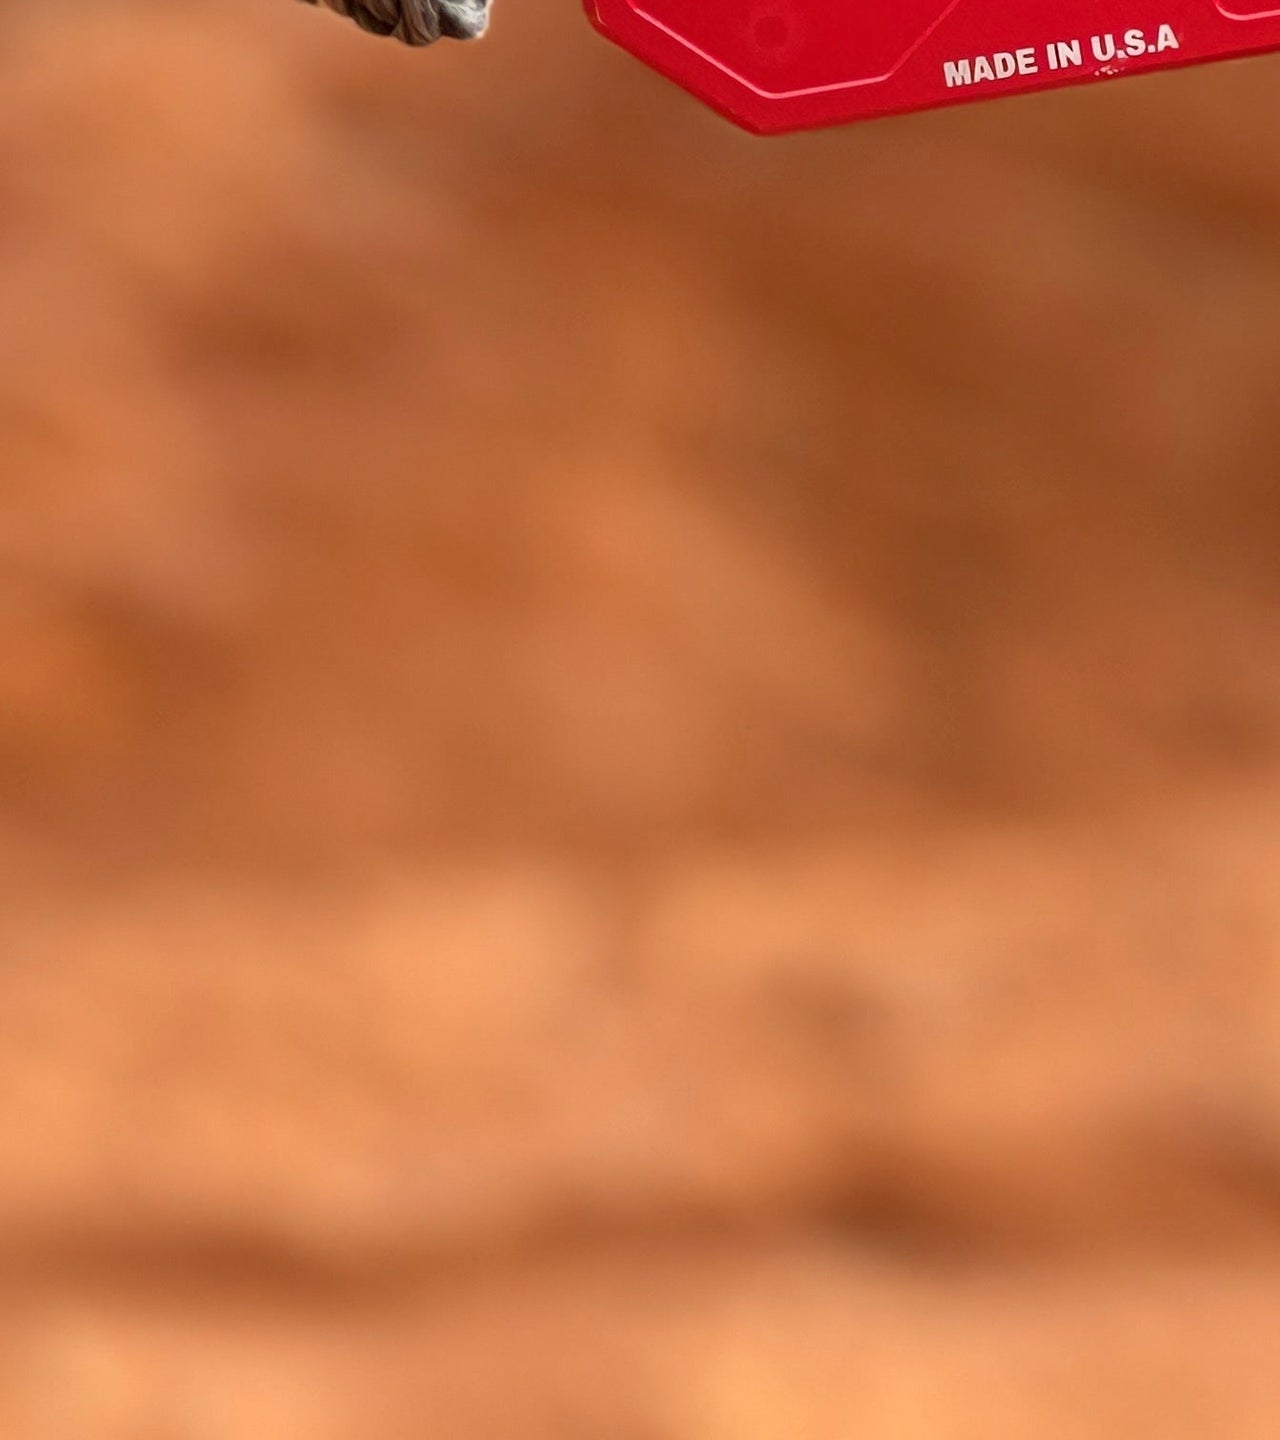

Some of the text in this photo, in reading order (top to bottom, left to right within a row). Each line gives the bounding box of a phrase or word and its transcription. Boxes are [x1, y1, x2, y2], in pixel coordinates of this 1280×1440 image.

[943, 24, 1179, 87] MADE IN U.S.A
